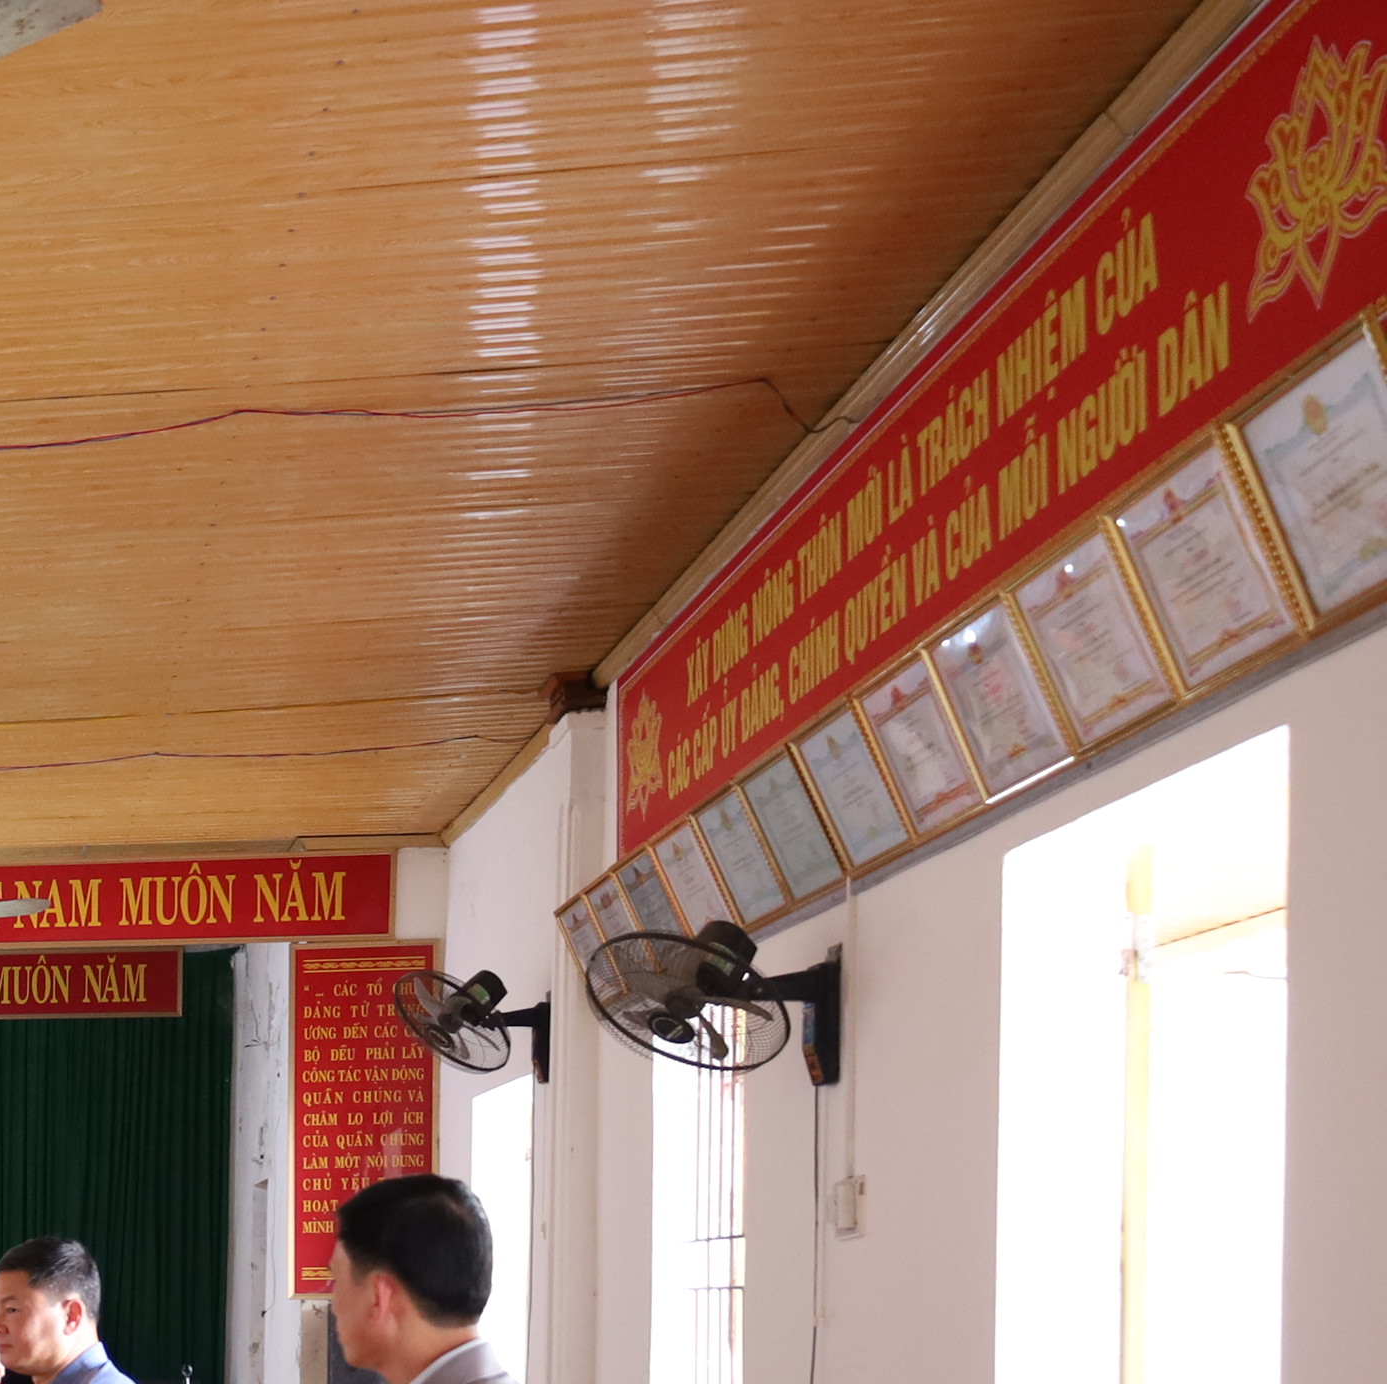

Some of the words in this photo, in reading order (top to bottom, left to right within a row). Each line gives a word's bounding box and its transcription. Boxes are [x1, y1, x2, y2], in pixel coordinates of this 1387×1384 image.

[686, 638, 709, 706] XÂY
[712, 599, 749, 683] DỰNG
[752, 558, 794, 646] NÔNG
[798, 513, 841, 604] THÔN
[847, 466, 882, 562] MỚI
[888, 434, 913, 525] LÀ
[917, 370, 989, 495] TRÁCH
[997, 276, 1086, 427] NHIỆM
[1096, 207, 1158, 336] CỦA
[667, 720, 690, 800] CÁC
[694, 704, 718, 780] CẤP
[721, 679, 738, 758] ỦY
[741, 663, 784, 747] ĐẢNG,
[788, 610, 839, 704] CHÍNH
[844, 545, 907, 662] QUYỀN
[912, 515, 939, 607] VÀ
[945, 476, 992, 580] CỦA
[998, 412, 1049, 540] MỖI
[1058, 345, 1147, 495] NGƯỜI
[1158, 281, 1229, 417] DÂN
[13, 879, 102, 930] NAM
[118, 862, 236, 927] MUÔN
[253, 859, 346, 923] NĂM
[82, 955, 147, 1004] NĂM
[347, 1113, 363, 1125] LO
[391, 1154, 424, 1168] DUNG
[302, 1217, 334, 1234] MÌNH
